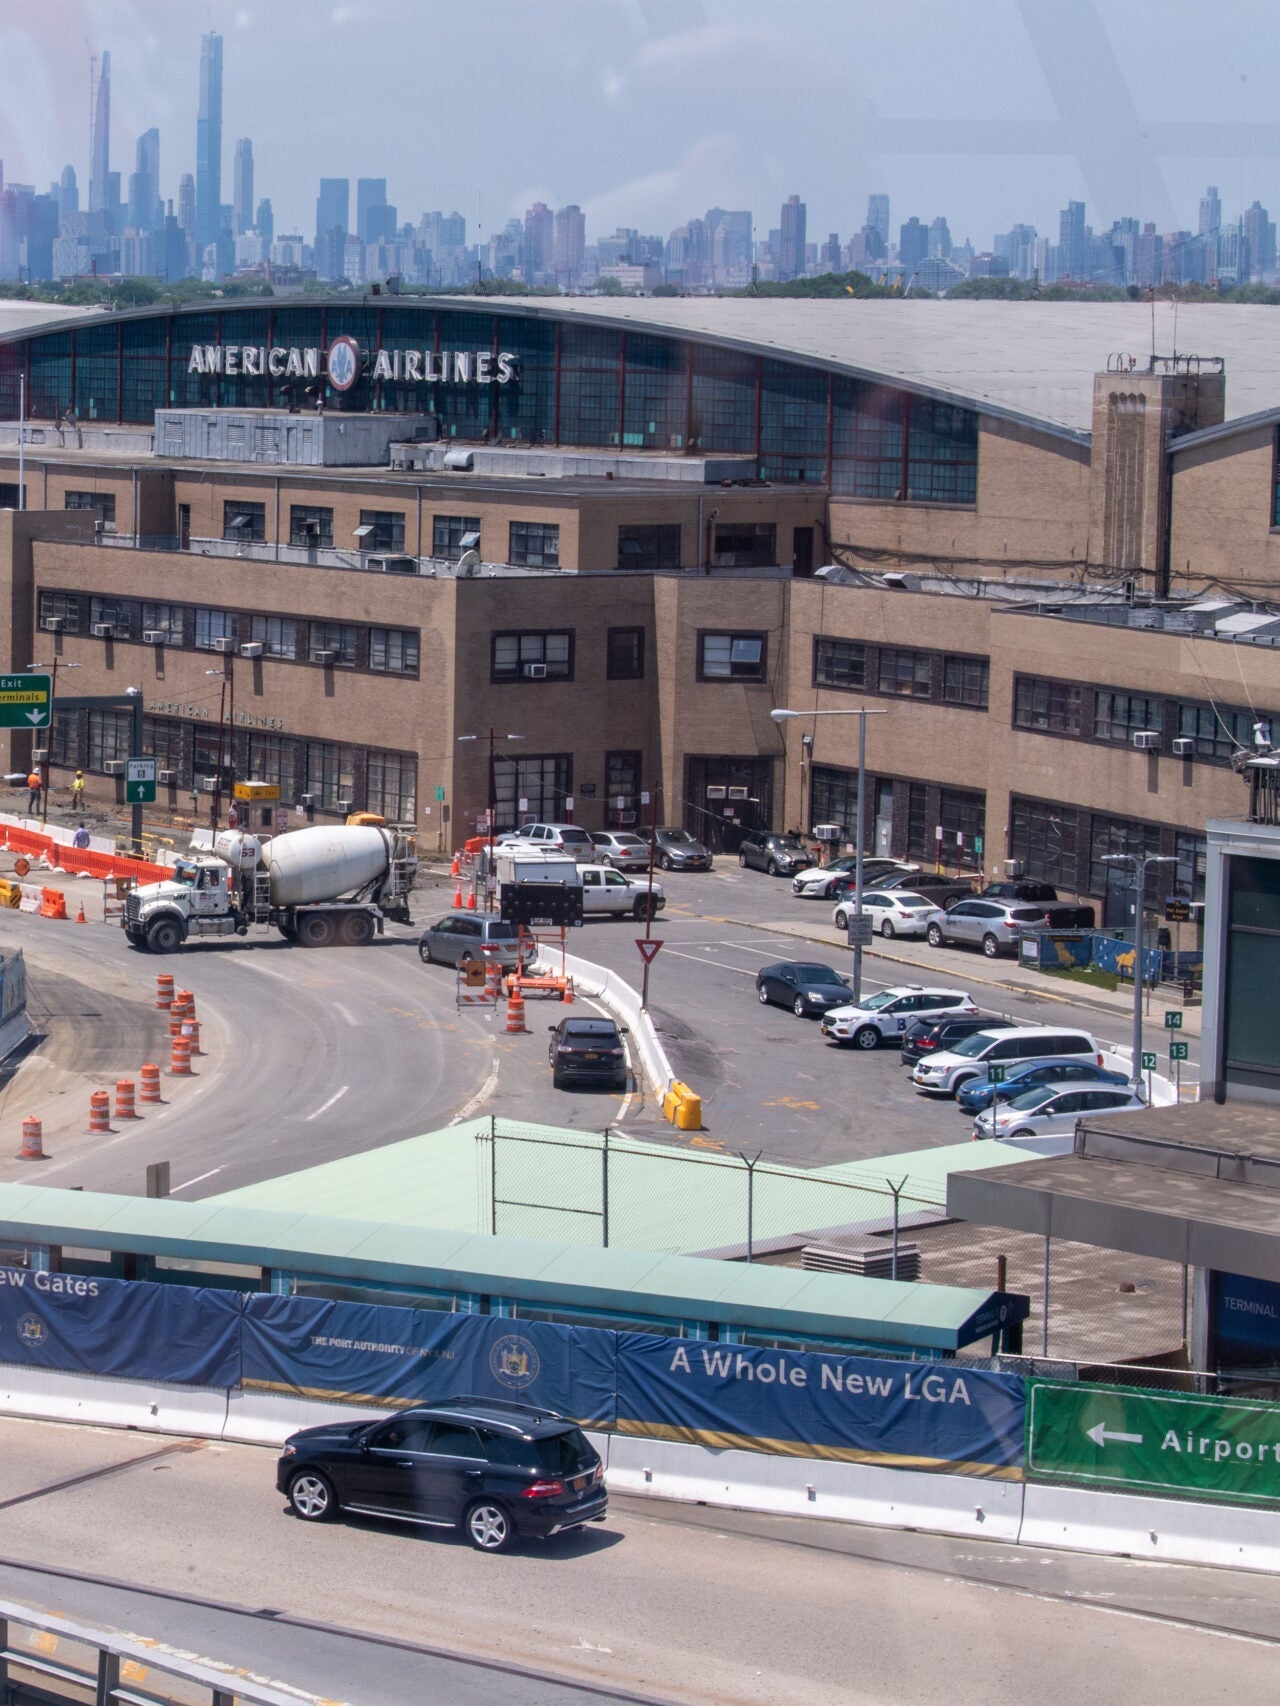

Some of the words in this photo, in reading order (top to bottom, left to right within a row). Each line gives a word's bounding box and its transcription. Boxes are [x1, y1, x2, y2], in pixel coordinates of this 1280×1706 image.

[188, 344, 318, 377] AMERICAN
[374, 349, 516, 384] AIRLINES
[1, 679, 22, 688] Exit
[149, 701, 210, 718] AMERICAN
[224, 711, 284, 730] AIRLINES
[1166, 1014, 1181, 1025] 14
[1142, 1055, 1156, 1067] 12
[1171, 1045, 1185, 1057] 13
[989, 1067, 1004, 1080] 11
[34, 1271, 100, 1297] Gates
[1224, 1295, 1277, 1319] TERMINAL
[310, 1335, 328, 1346] THE
[328, 1337, 353, 1349] PORT
[353, 1340, 405, 1355] AUTHORITY
[406, 1347, 419, 1356] OF
[442, 1350, 455, 1360] NJ
[670, 1346, 691, 1374] A
[702, 1349, 807, 1387] Whole
[821, 1363, 894, 1397] New
[904, 1372, 971, 1405] LGA
[1161, 1429, 1280, 1462] Airport
